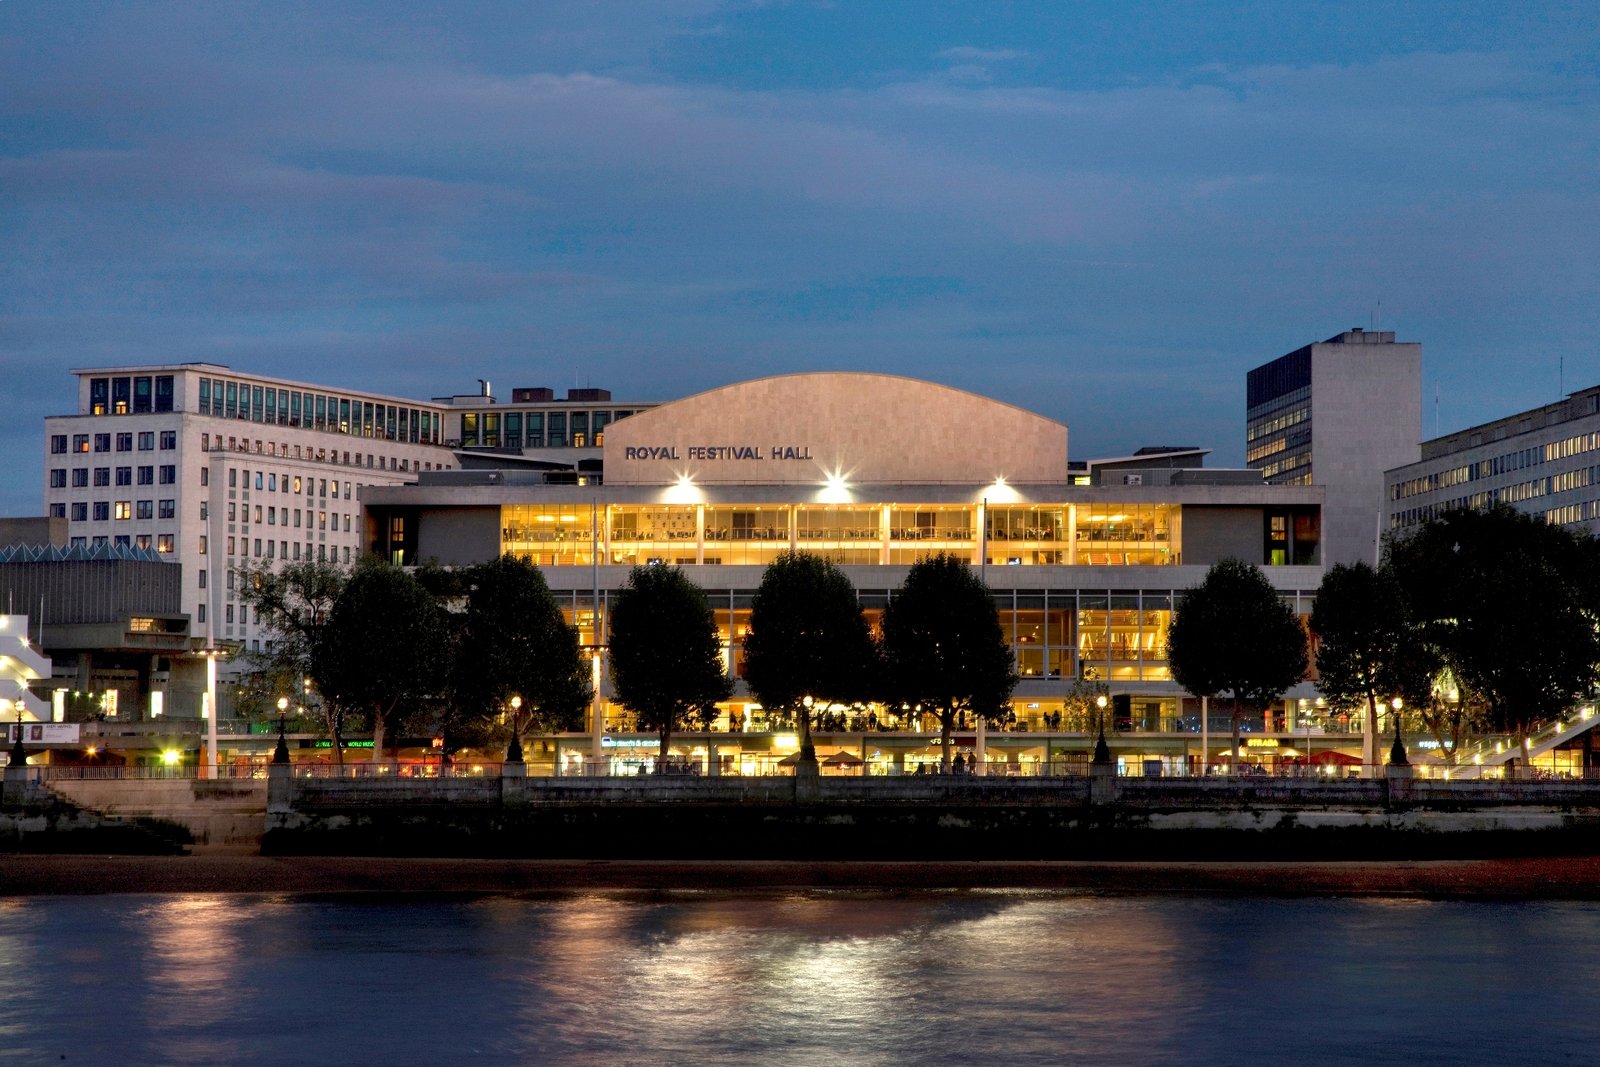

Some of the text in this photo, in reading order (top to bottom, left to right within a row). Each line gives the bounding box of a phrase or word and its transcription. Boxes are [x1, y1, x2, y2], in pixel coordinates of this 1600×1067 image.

[625, 446, 814, 460] ROYAL FESTIVAL HALL
[1247, 738, 1279, 747] STRADA
